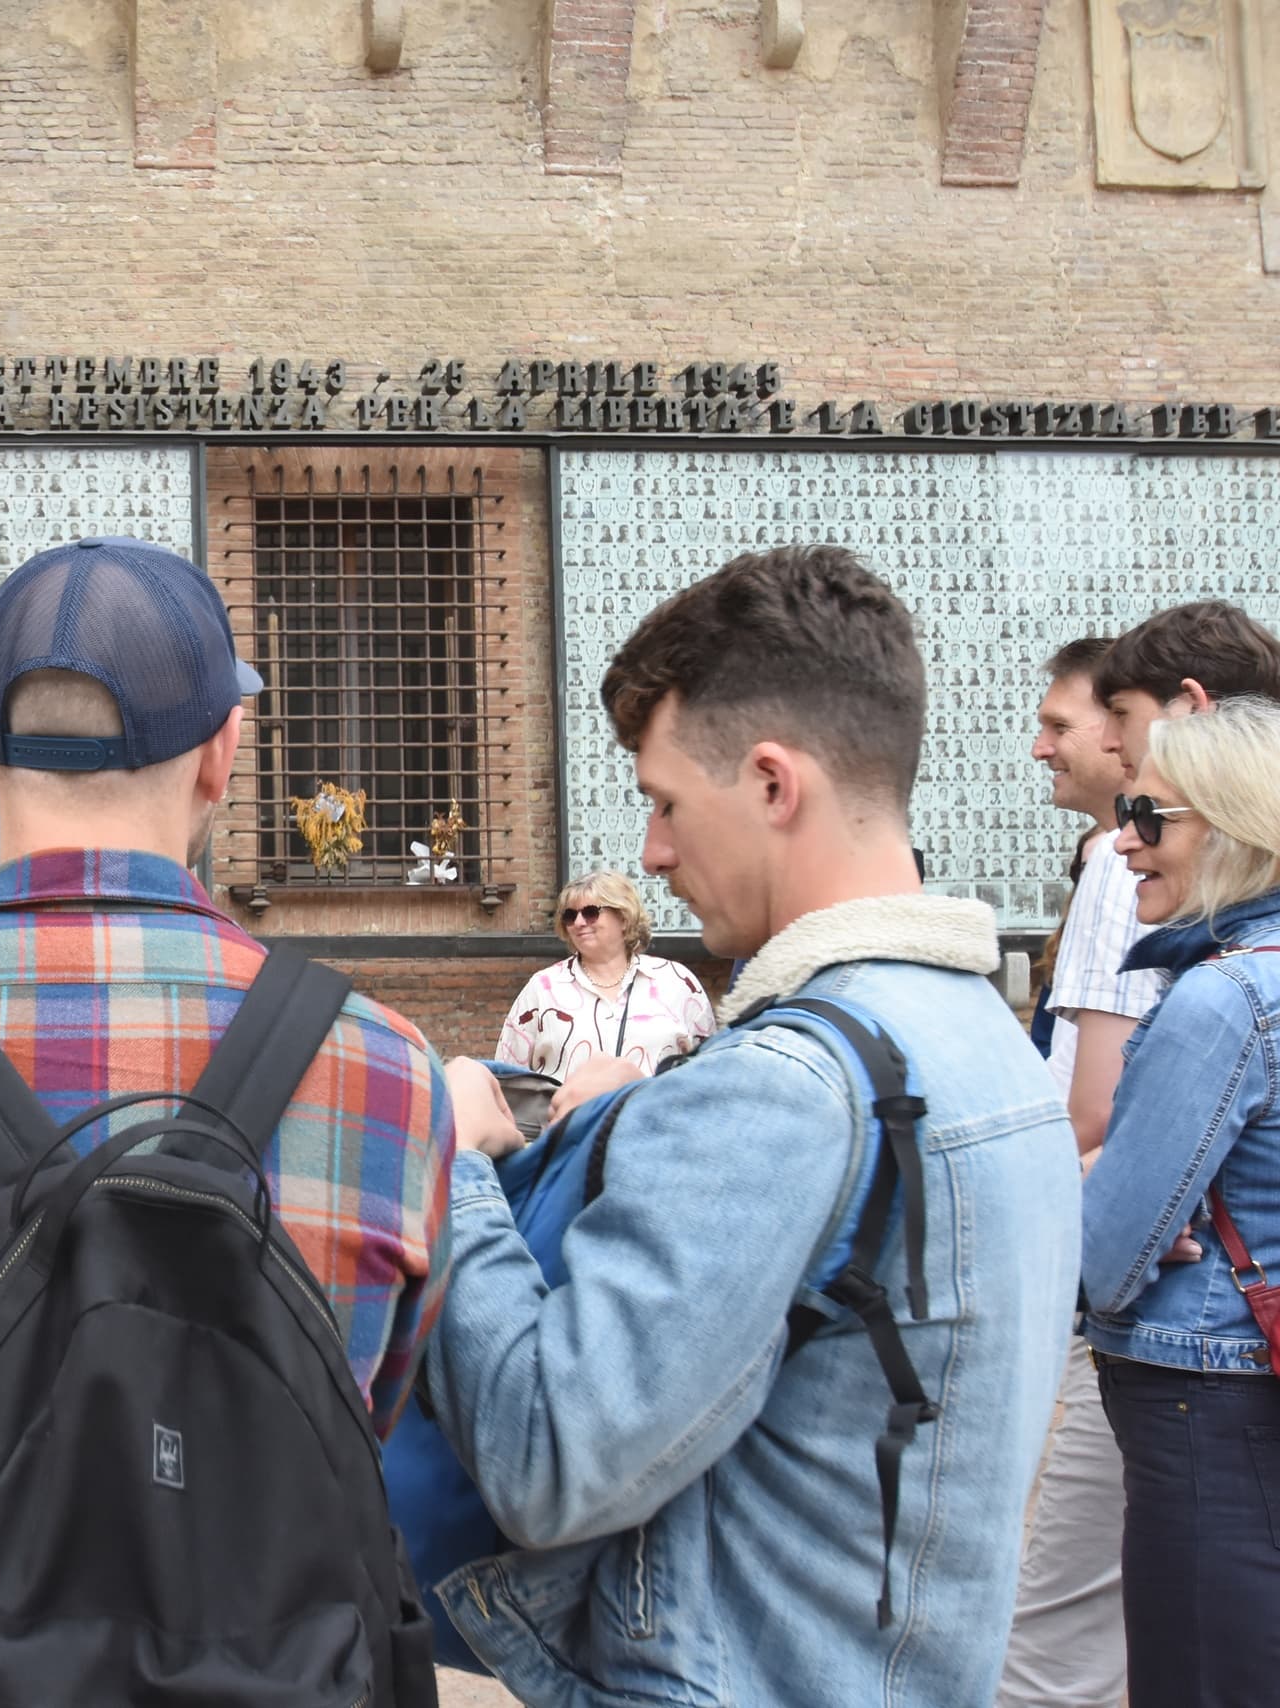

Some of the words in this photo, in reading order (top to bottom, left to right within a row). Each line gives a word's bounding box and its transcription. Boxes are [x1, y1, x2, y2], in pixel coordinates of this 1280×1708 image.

[250, 357, 346, 395] 1943
[421, 358, 465, 395] 25
[501, 360, 658, 397] APRILE
[683, 361, 781, 399] 1945
[50, 395, 326, 430] RESISTENZA
[357, 395, 442, 431] PER
[469, 395, 525, 431] LA
[770, 399, 796, 433] E
[819, 400, 883, 434] LA
[904, 400, 1129, 437] GIUSTIZIA
[1152, 402, 1235, 438] PER
